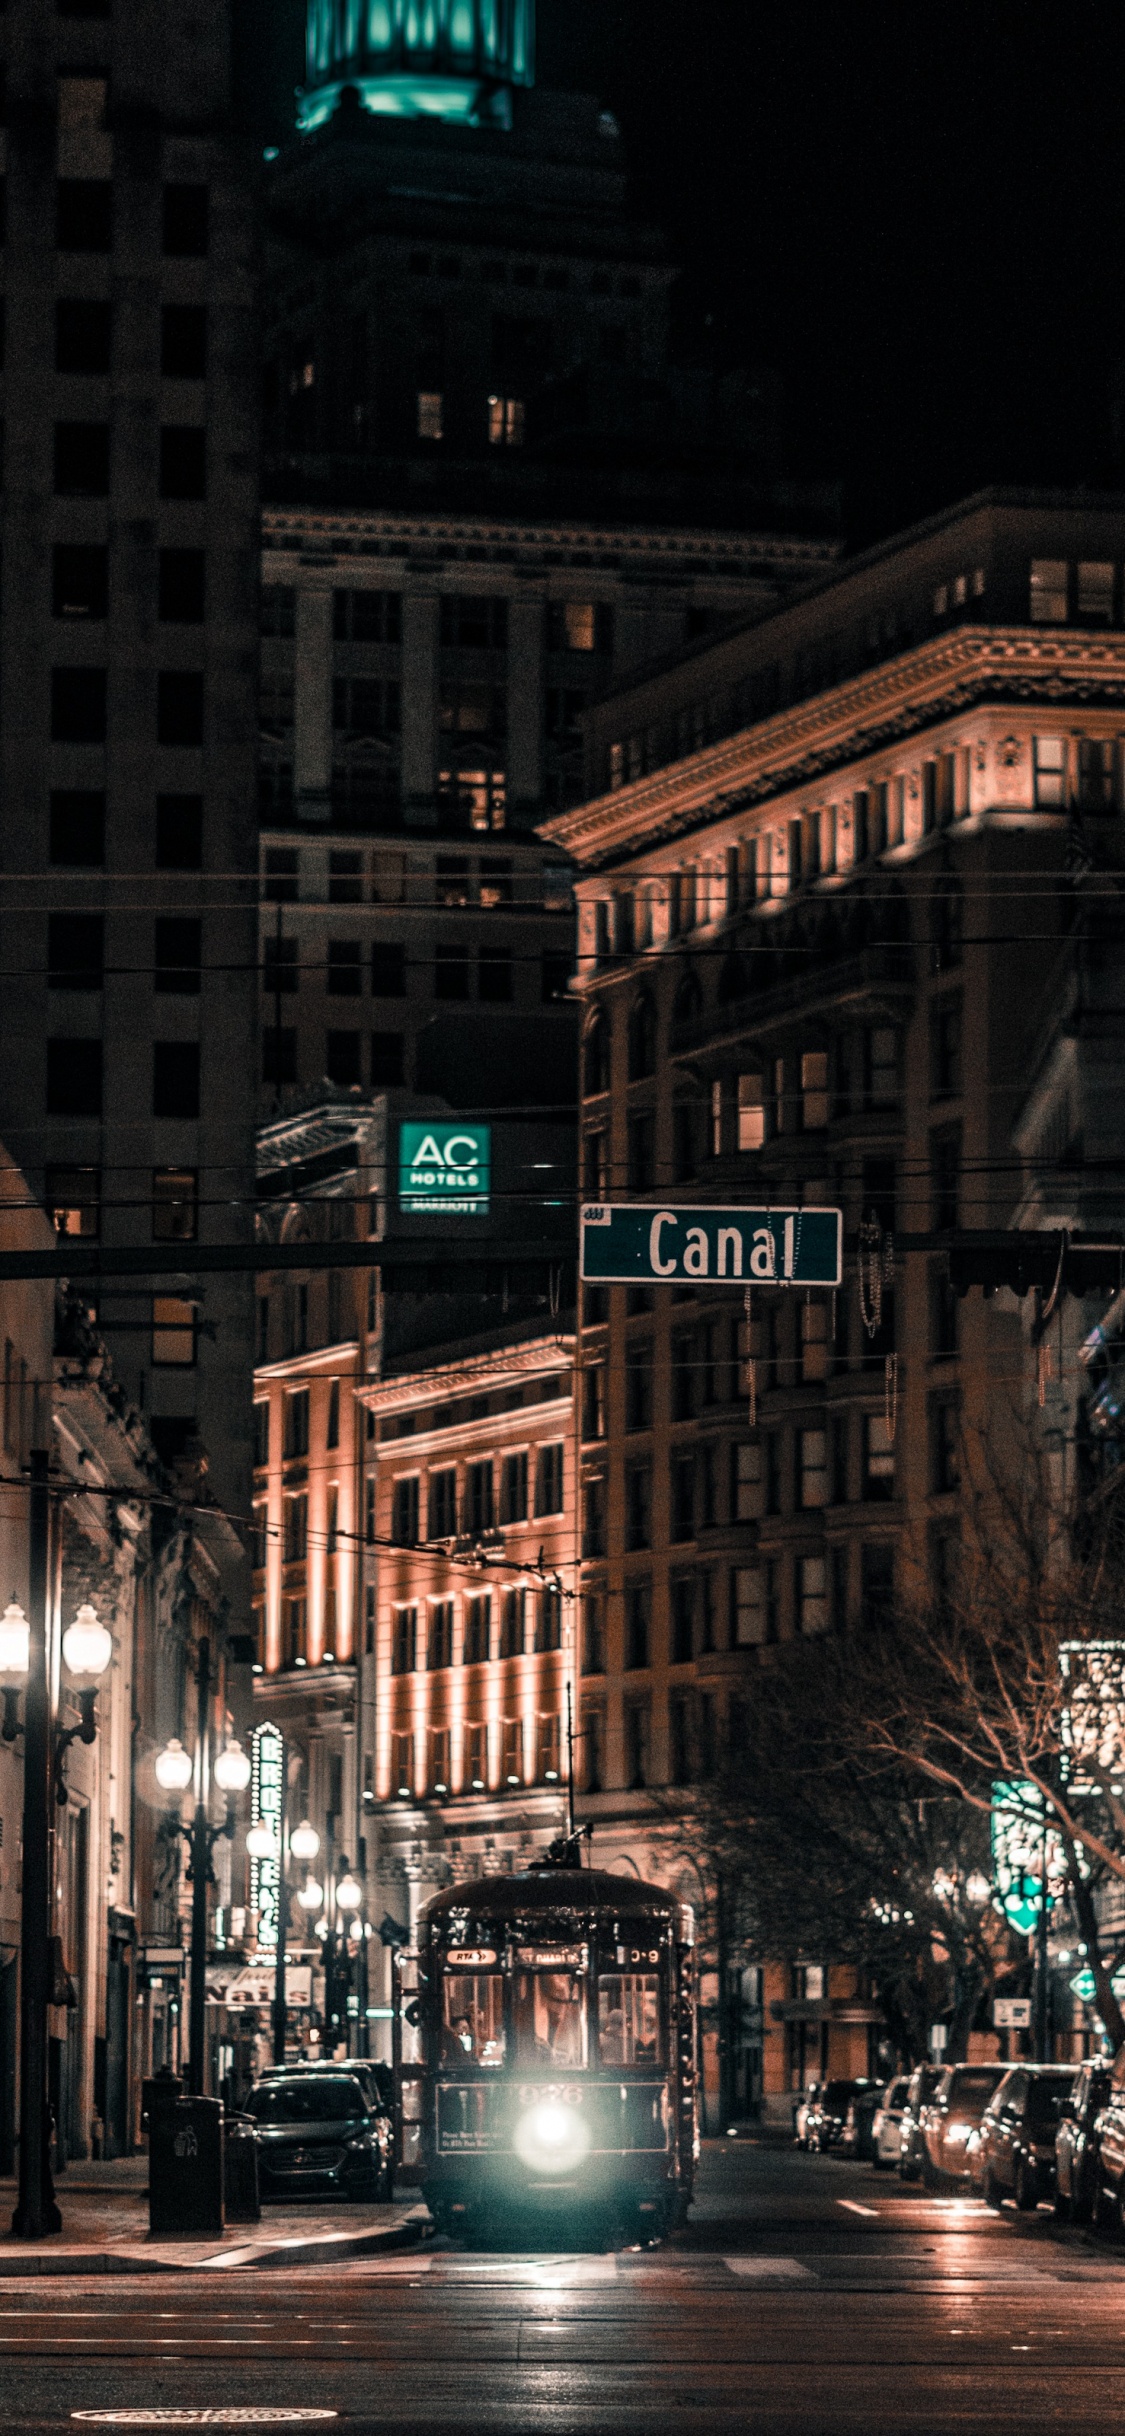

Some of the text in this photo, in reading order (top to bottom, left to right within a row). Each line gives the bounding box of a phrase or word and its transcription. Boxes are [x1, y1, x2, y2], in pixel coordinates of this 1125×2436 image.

[411, 1134, 479, 1171] AC
[410, 1172, 479, 1186] HOTELS
[649, 1211, 794, 1278] Canal
[204, 1985, 308, 2002] Nais
